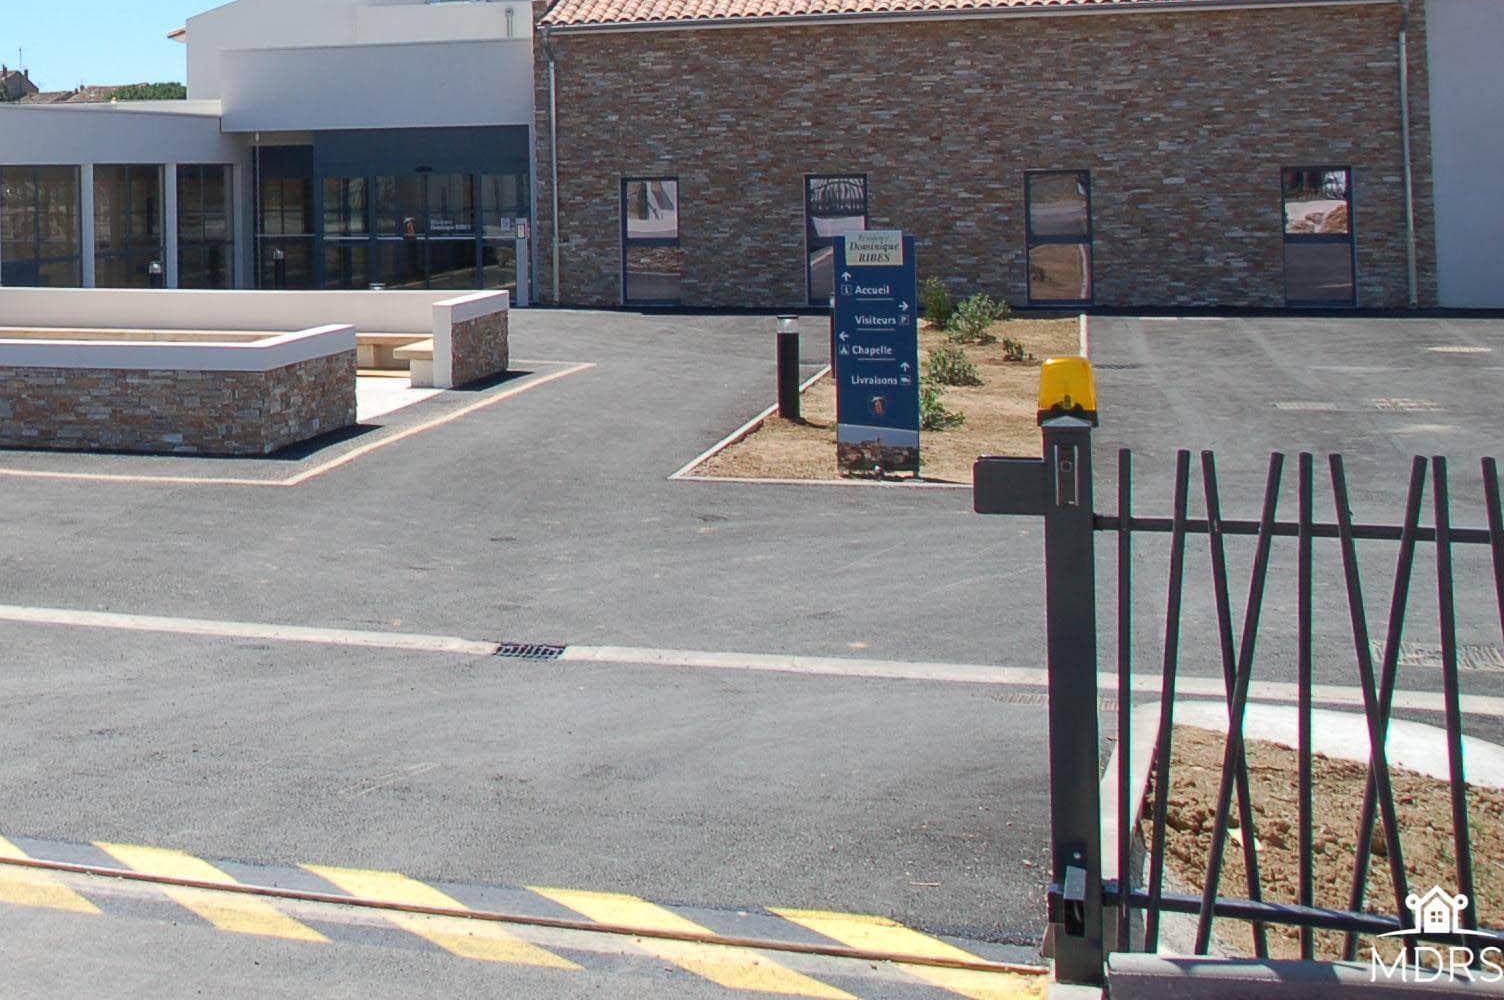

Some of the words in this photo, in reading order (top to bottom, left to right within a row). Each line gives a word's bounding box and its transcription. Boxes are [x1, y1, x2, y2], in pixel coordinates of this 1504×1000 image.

[858, 252, 890, 262] RIBES
[855, 284, 890, 295] Accueil
[855, 315, 897, 325] Visiteurs
[851, 345, 893, 356] Chapelle
[851, 376, 898, 385] Livraisons
